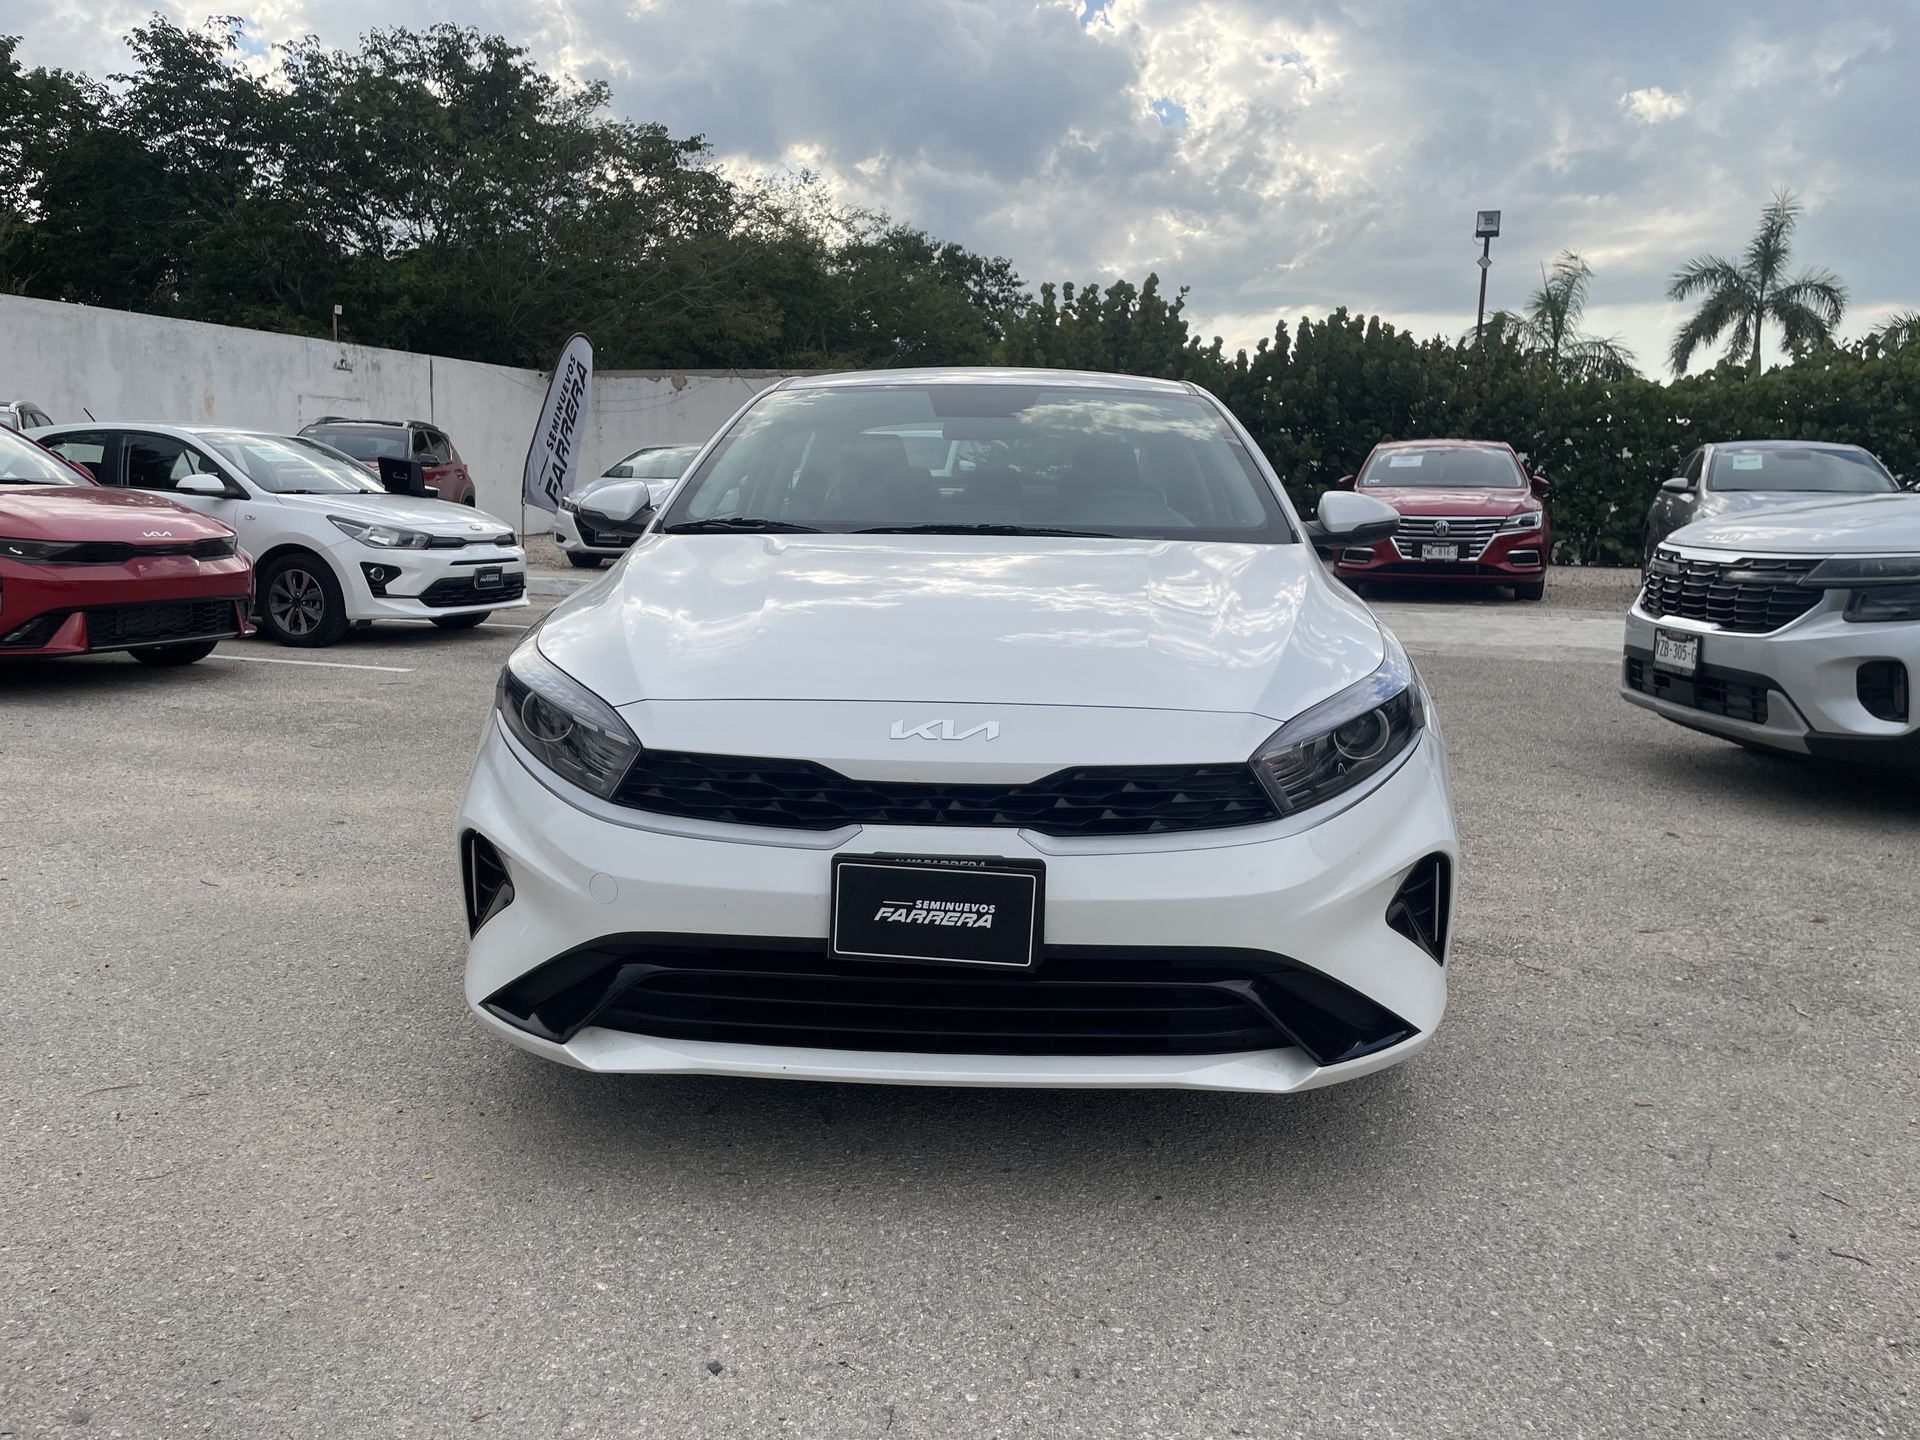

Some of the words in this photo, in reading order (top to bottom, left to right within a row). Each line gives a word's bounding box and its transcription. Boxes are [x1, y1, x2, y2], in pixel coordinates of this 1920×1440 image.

[546, 353, 576, 451] SEMINUEVOS
[545, 360, 588, 506] FARRERA
[889, 719, 1000, 741] KIA
[915, 900, 996, 913] SEMINUEVOS
[874, 907, 993, 929] FARRERA
